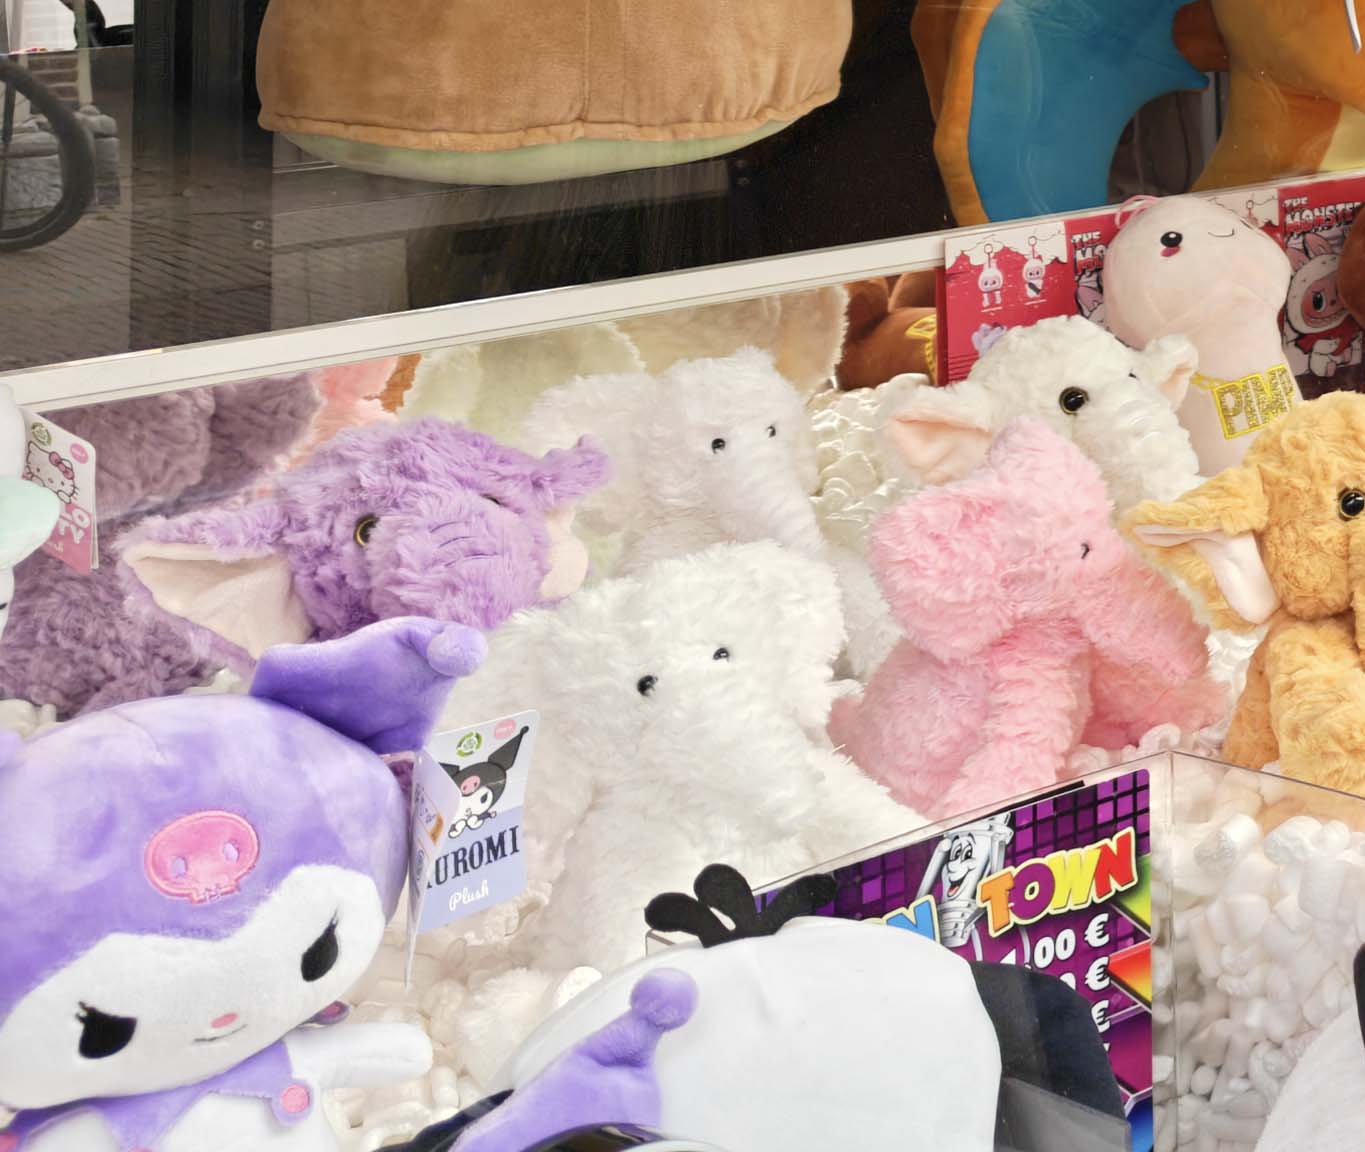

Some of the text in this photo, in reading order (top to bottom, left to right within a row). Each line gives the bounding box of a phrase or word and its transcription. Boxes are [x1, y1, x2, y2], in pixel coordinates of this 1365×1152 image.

[426, 825, 520, 889] UROMI
[449, 879, 489, 911] Plush
[979, 828, 1137, 937] TOWN
[1084, 913, 1111, 948] €
[1085, 956, 1111, 992] €
